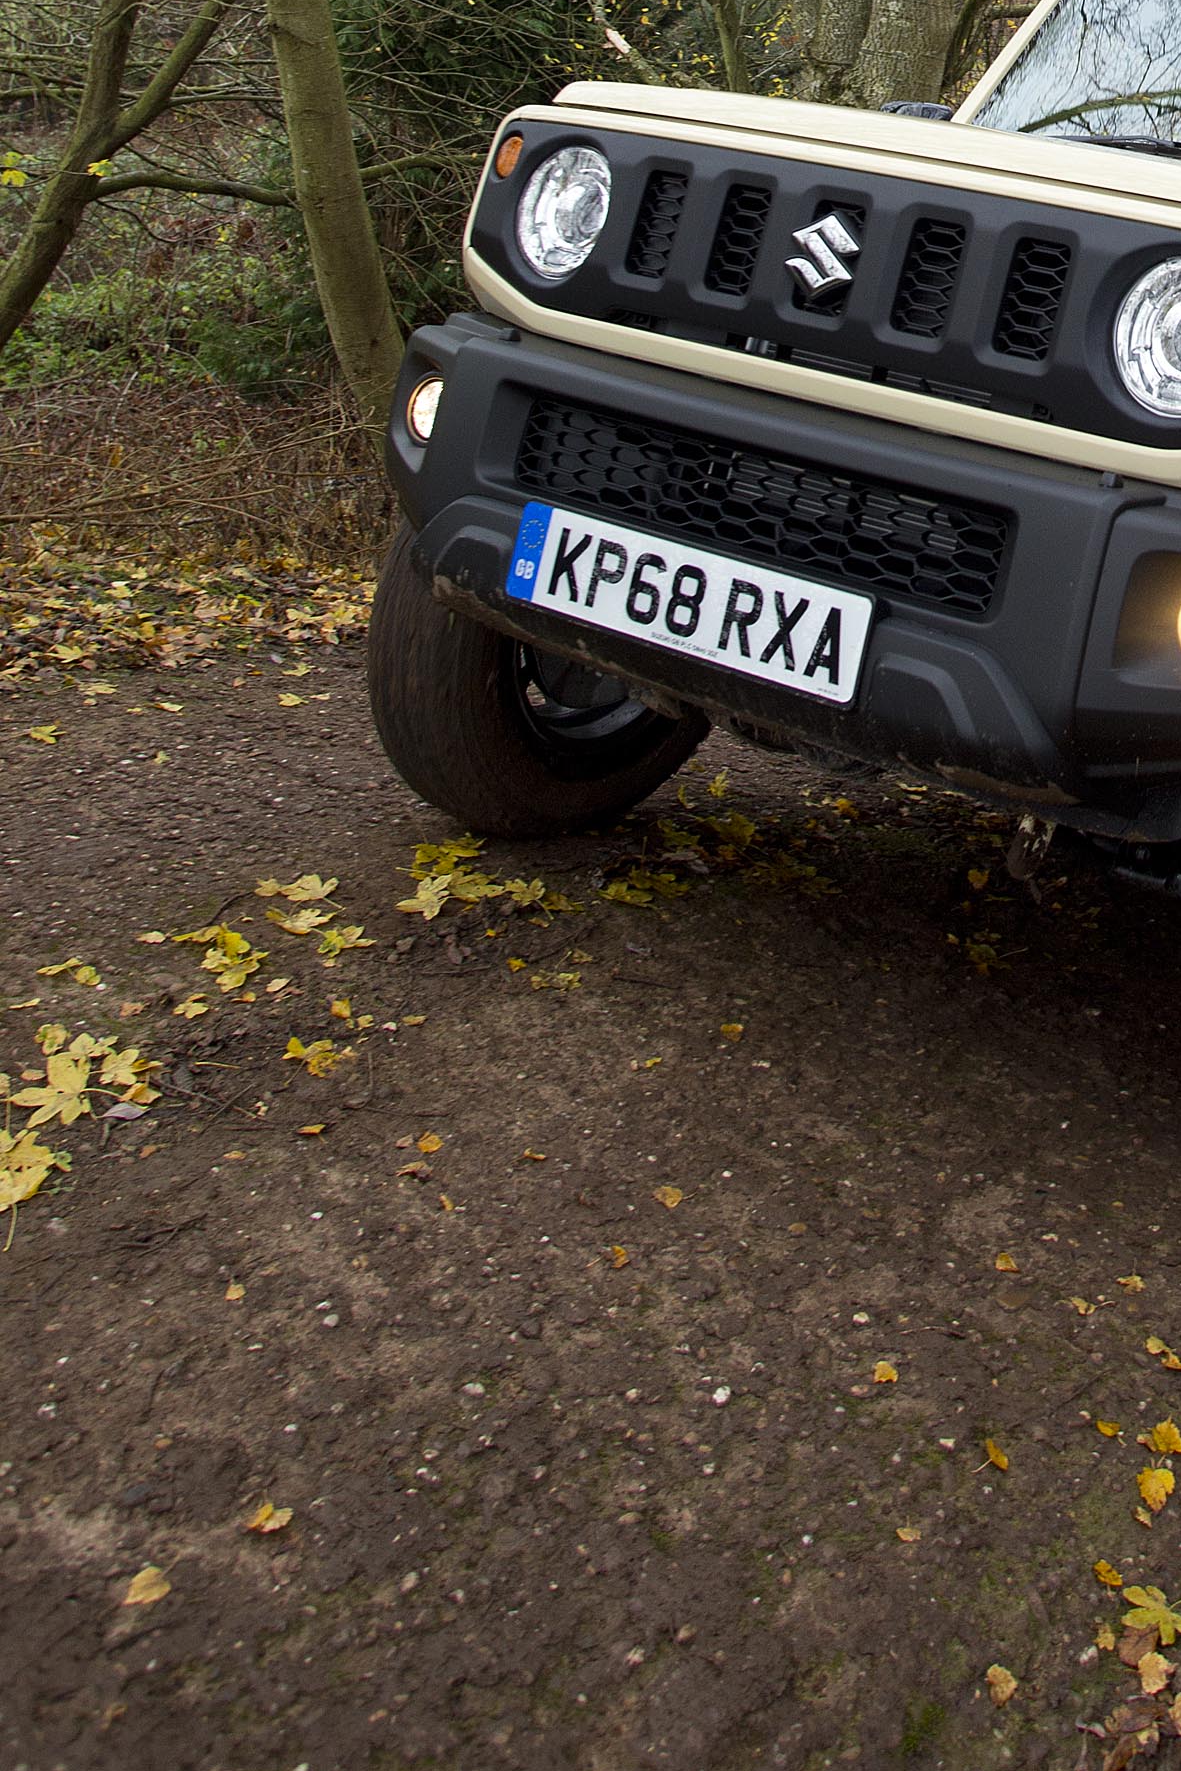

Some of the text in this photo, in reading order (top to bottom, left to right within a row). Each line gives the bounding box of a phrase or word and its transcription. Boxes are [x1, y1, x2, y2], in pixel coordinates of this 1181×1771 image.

[515, 558, 535, 580] GB
[547, 527, 842, 686] KP68 RXA
